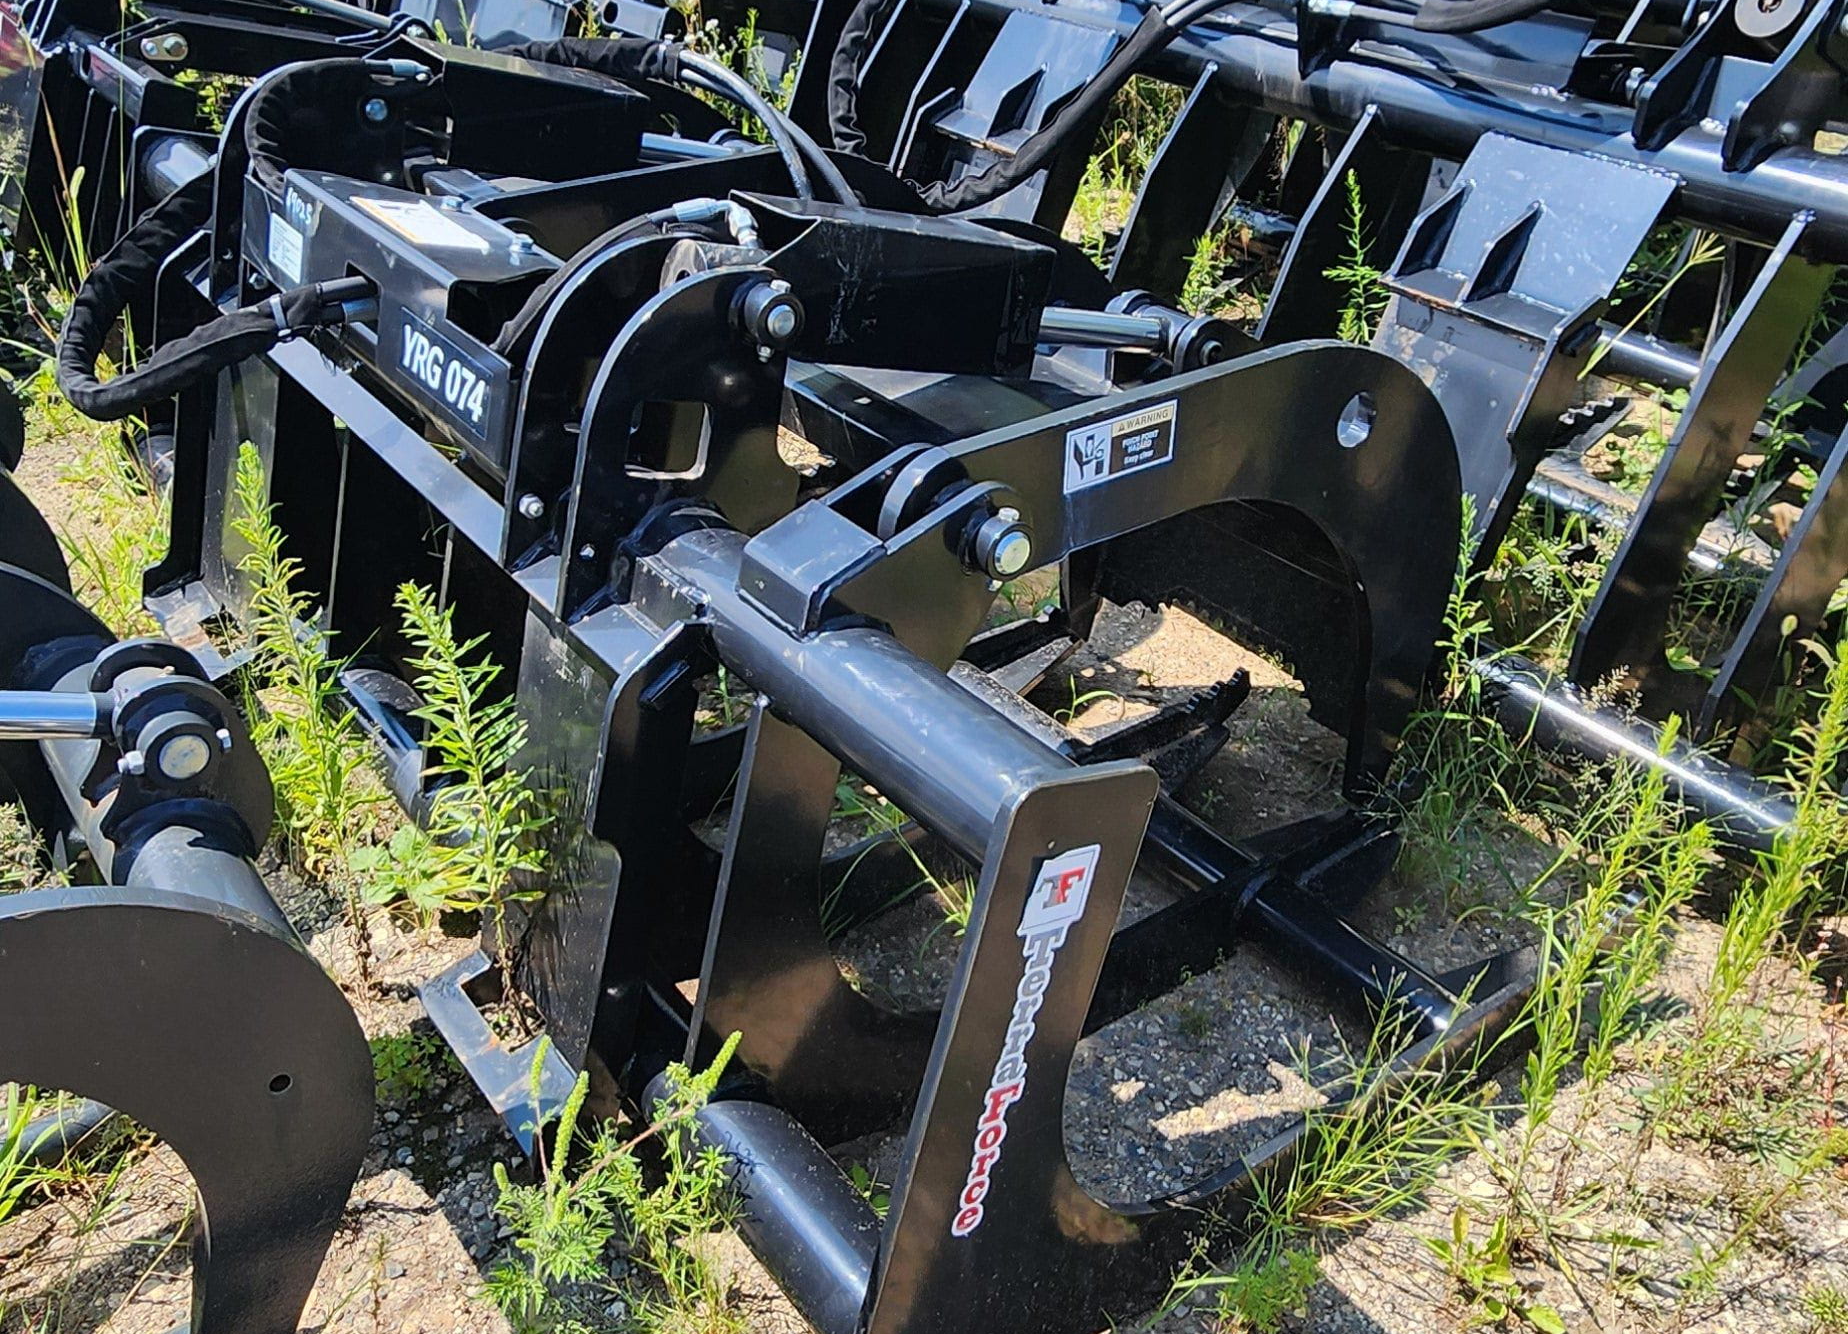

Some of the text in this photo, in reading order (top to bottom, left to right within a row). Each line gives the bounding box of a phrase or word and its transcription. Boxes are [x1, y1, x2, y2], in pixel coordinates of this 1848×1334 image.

[402, 324, 486, 423] YRG 074
[1127, 408, 1169, 428] WARNING
[955, 927, 1065, 1231] TerraForce
